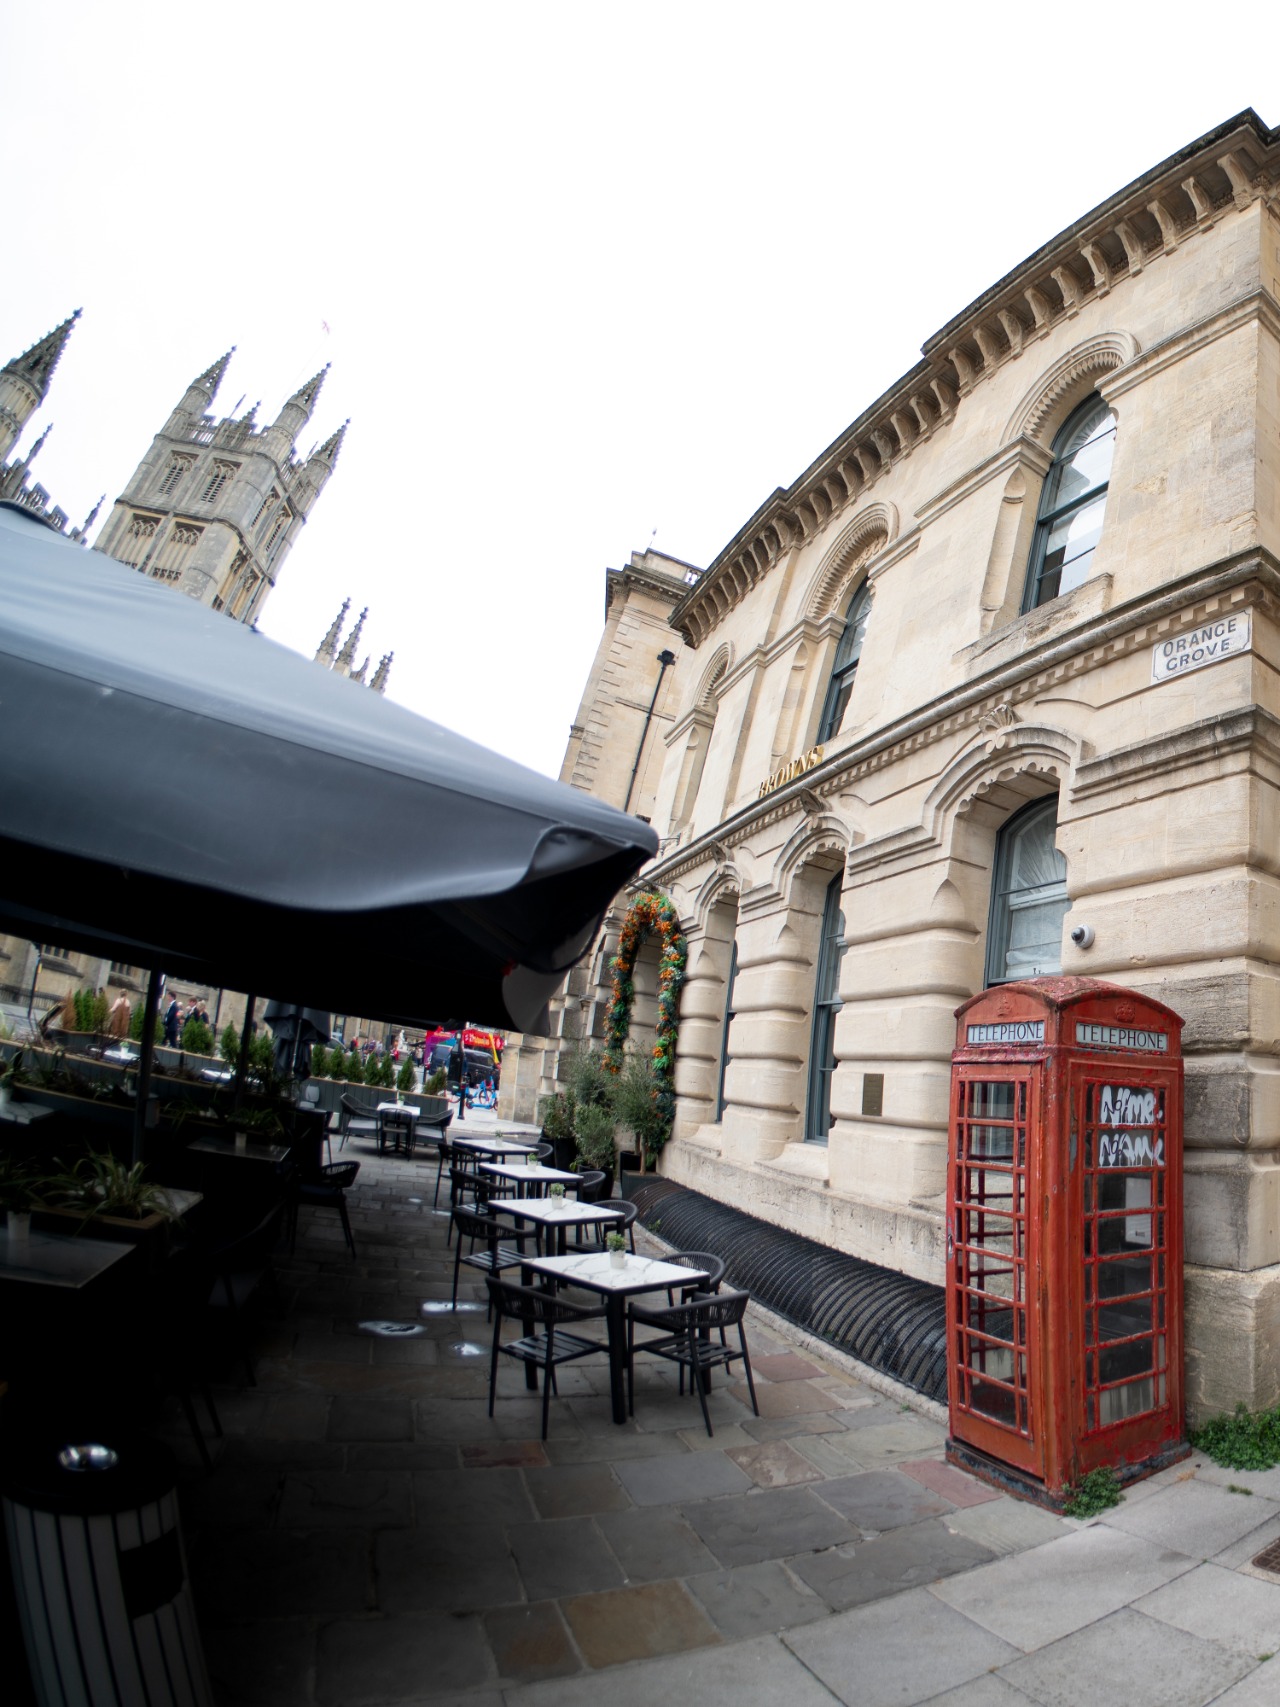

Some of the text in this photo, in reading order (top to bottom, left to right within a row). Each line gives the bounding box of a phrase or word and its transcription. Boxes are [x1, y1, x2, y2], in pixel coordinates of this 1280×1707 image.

[1163, 618, 1237, 657] ORANGE
[1166, 638, 1230, 671] GROVE
[971, 1021, 1043, 1042] TELEPHONE
[1080, 1024, 1166, 1050] TELEPHONE
